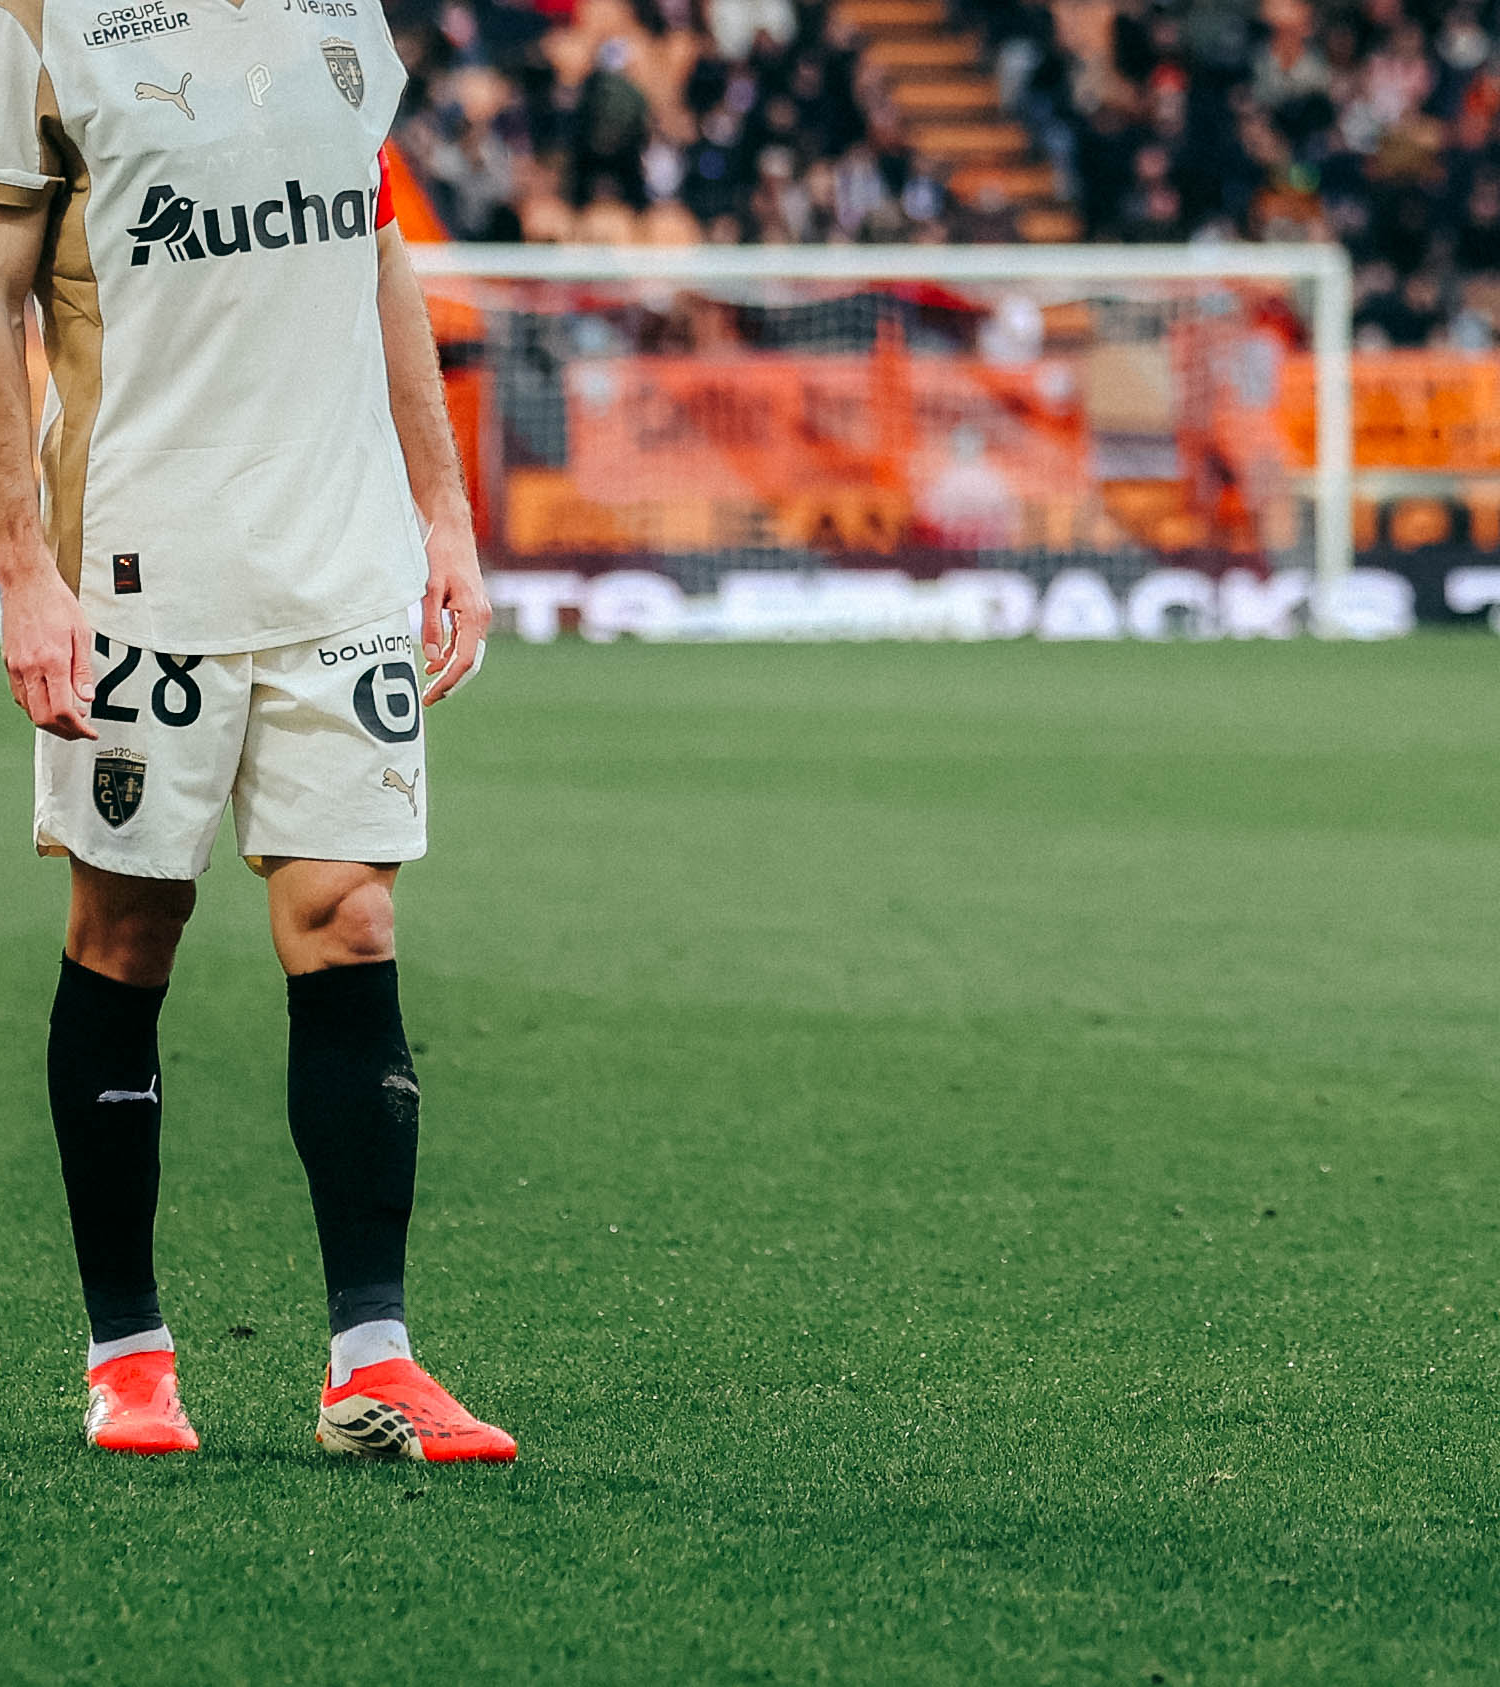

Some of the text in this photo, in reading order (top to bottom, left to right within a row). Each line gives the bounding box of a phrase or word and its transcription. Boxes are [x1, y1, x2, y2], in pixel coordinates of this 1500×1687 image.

[83, 12, 191, 46] LEMPEREUR
[97, 0, 167, 27] GROUPE
[90, 632, 203, 728] 28
